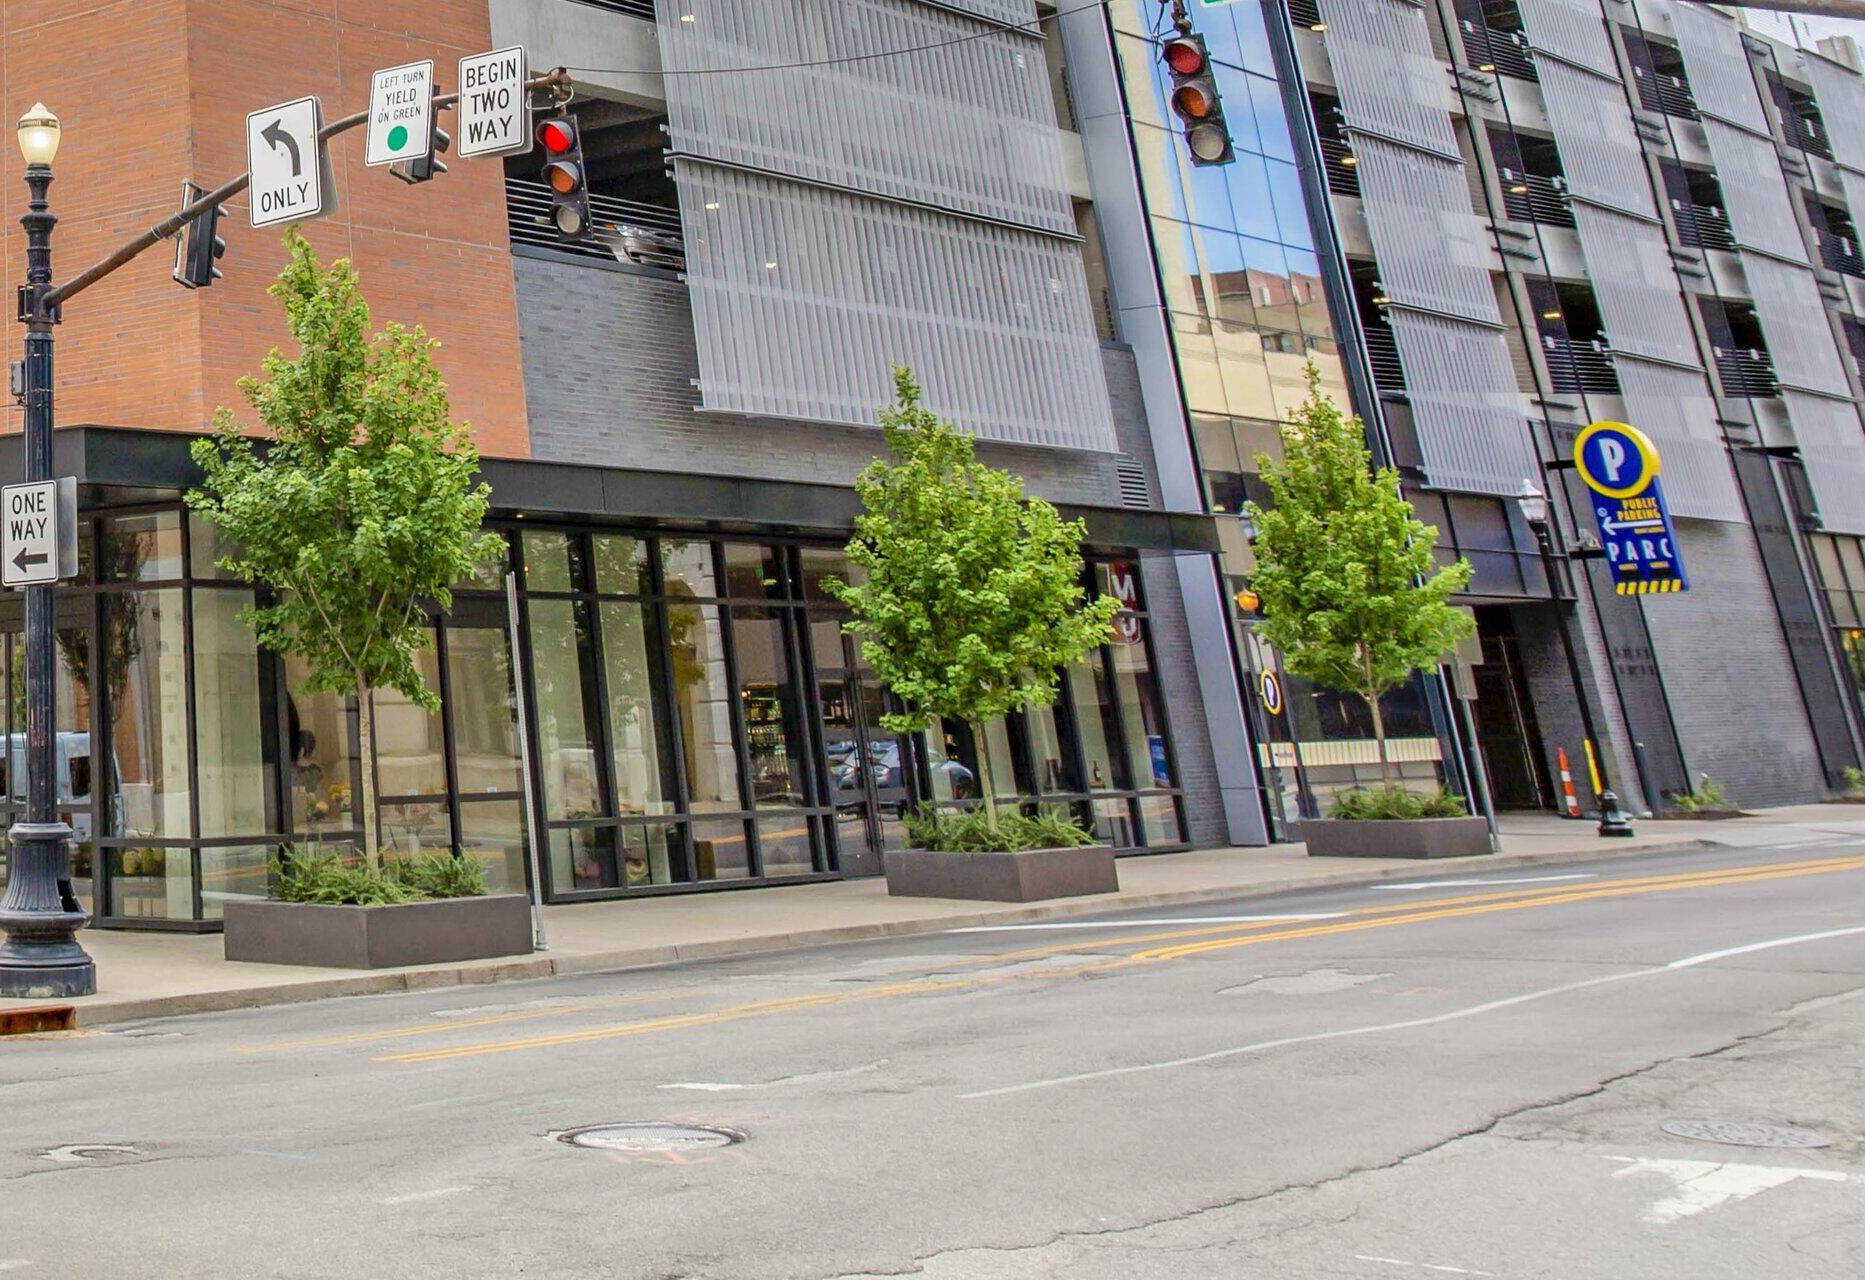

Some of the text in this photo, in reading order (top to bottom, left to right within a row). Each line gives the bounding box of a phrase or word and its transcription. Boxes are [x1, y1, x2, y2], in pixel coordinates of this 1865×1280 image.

[379, 69, 425, 90] LEFT TURN
[466, 61, 518, 89] BEGIN
[384, 88, 418, 107] YIELD
[470, 92, 511, 115] TWO
[377, 104, 422, 124] ON GREEN
[468, 115, 513, 144] WAY
[260, 181, 310, 214] ONLY
[1597, 438, 1626, 482] P
[11, 491, 47, 516] ONE
[1616, 507, 1662, 522] PARKING
[1621, 496, 1658, 510] PUBLIC
[10, 517, 48, 542] WAY
[1606, 537, 1674, 563] PARC
